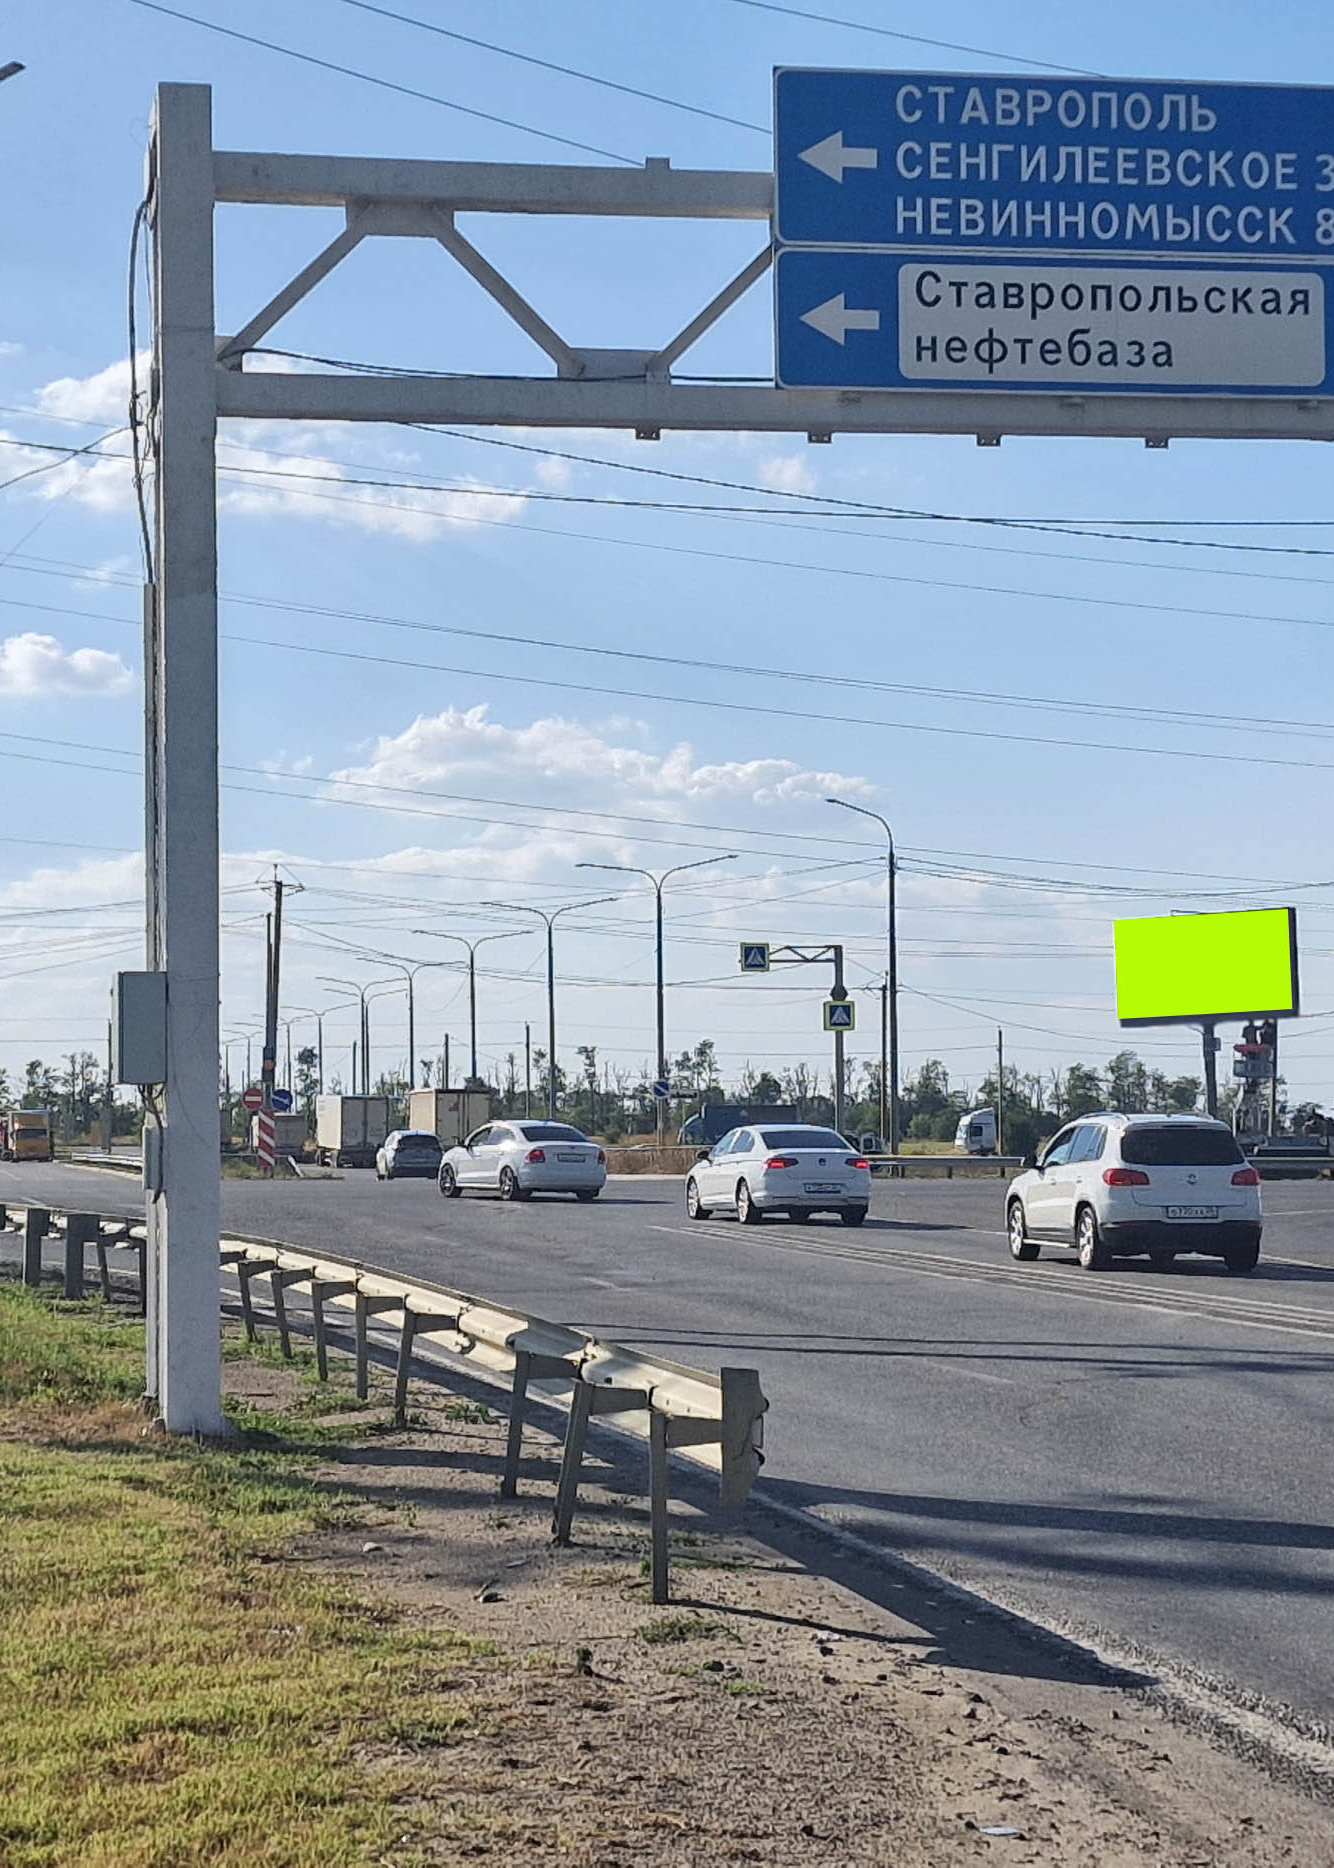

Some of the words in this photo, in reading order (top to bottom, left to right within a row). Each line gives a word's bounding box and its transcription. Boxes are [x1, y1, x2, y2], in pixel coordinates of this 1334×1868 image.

[895, 84, 1218, 132] СТАВРОПОЛЬ
[895, 140, 1298, 190] СЕНГИЛЕЕВСКОЕ
[895, 196, 1297, 245] НЕВИННОМЫССК
[914, 270, 1311, 321] Ставропольская
[915, 327, 1175, 375] нефтебаза
